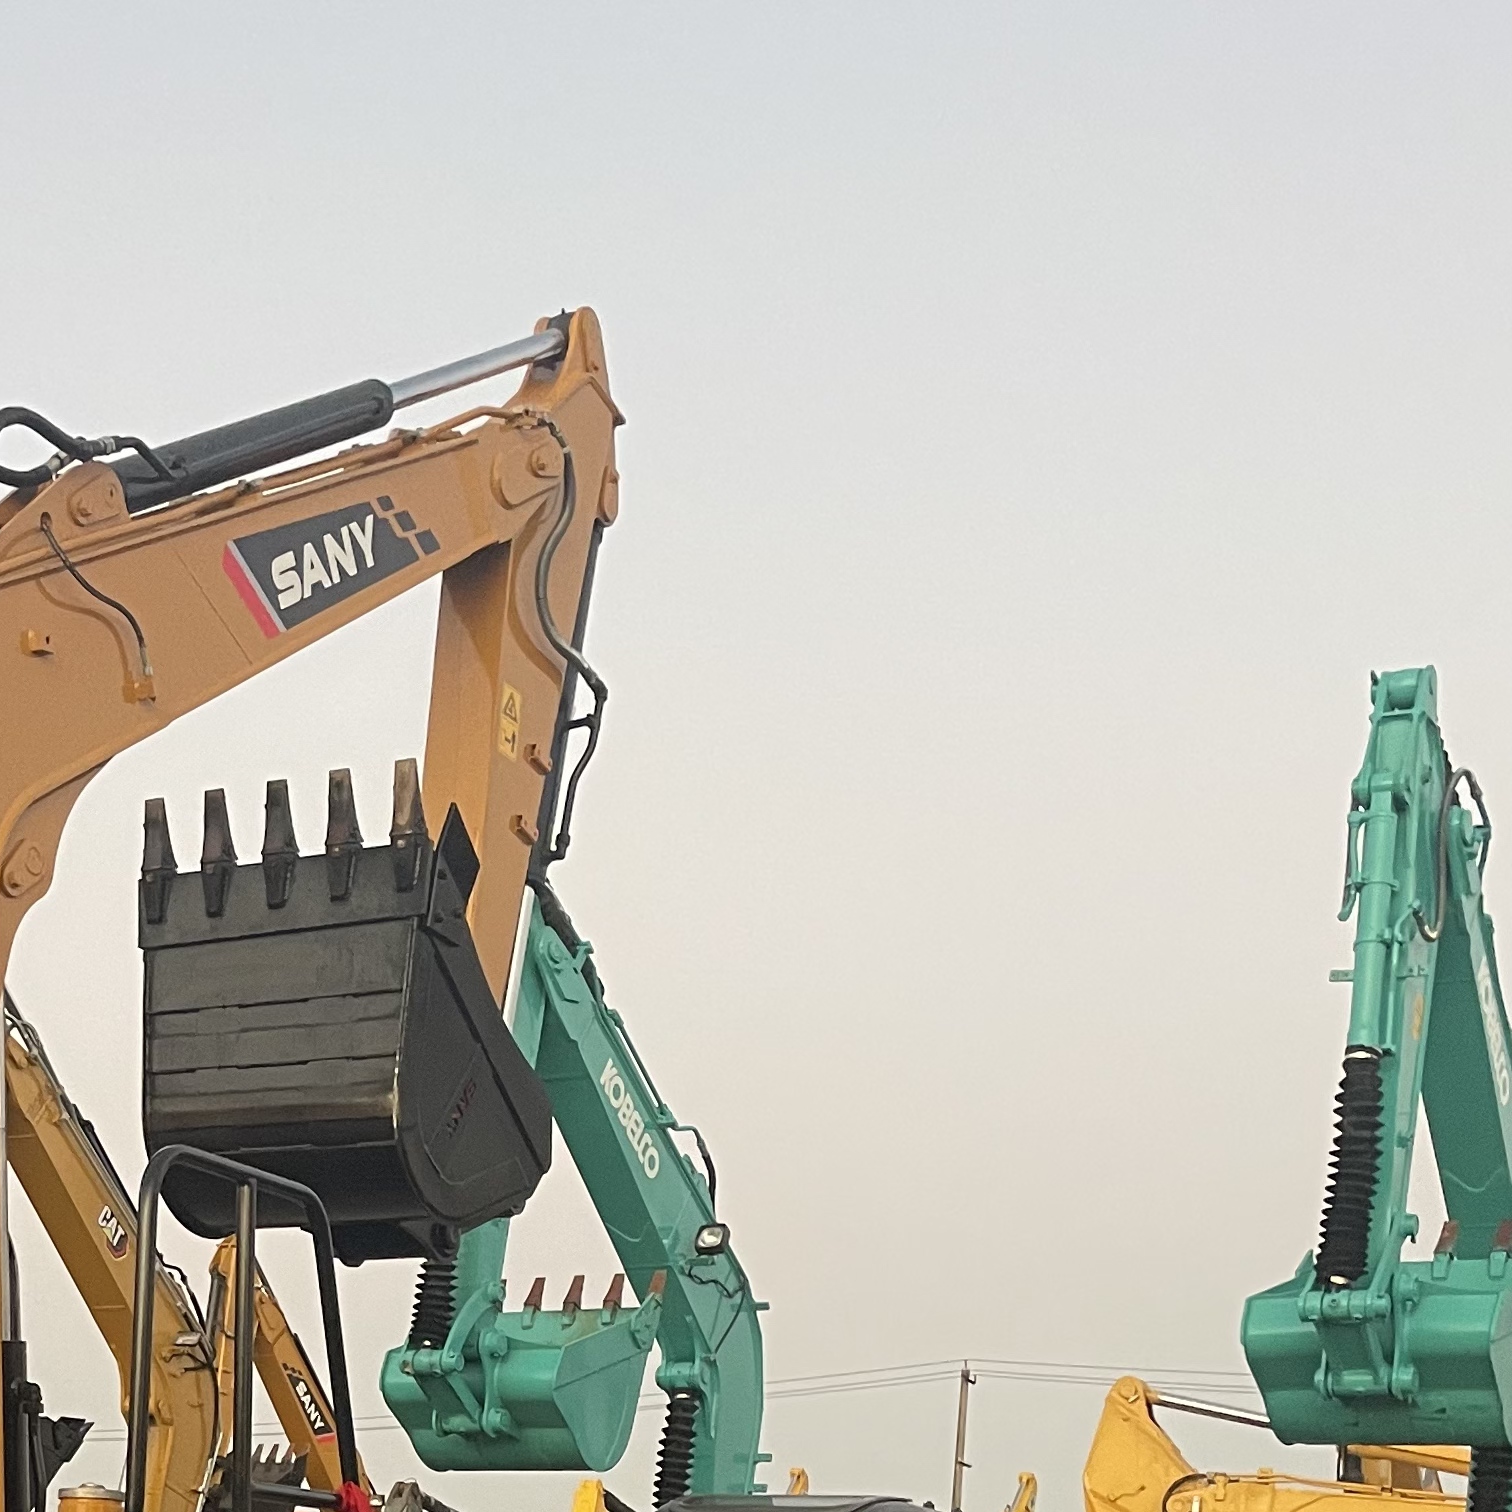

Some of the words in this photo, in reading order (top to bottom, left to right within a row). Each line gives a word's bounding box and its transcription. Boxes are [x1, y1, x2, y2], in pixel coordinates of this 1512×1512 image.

[272, 514, 374, 610] SANY
[599, 1057, 660, 1179] KOBELCO
[98, 1205, 125, 1247] CAT
[295, 1381, 325, 1430] SANY
